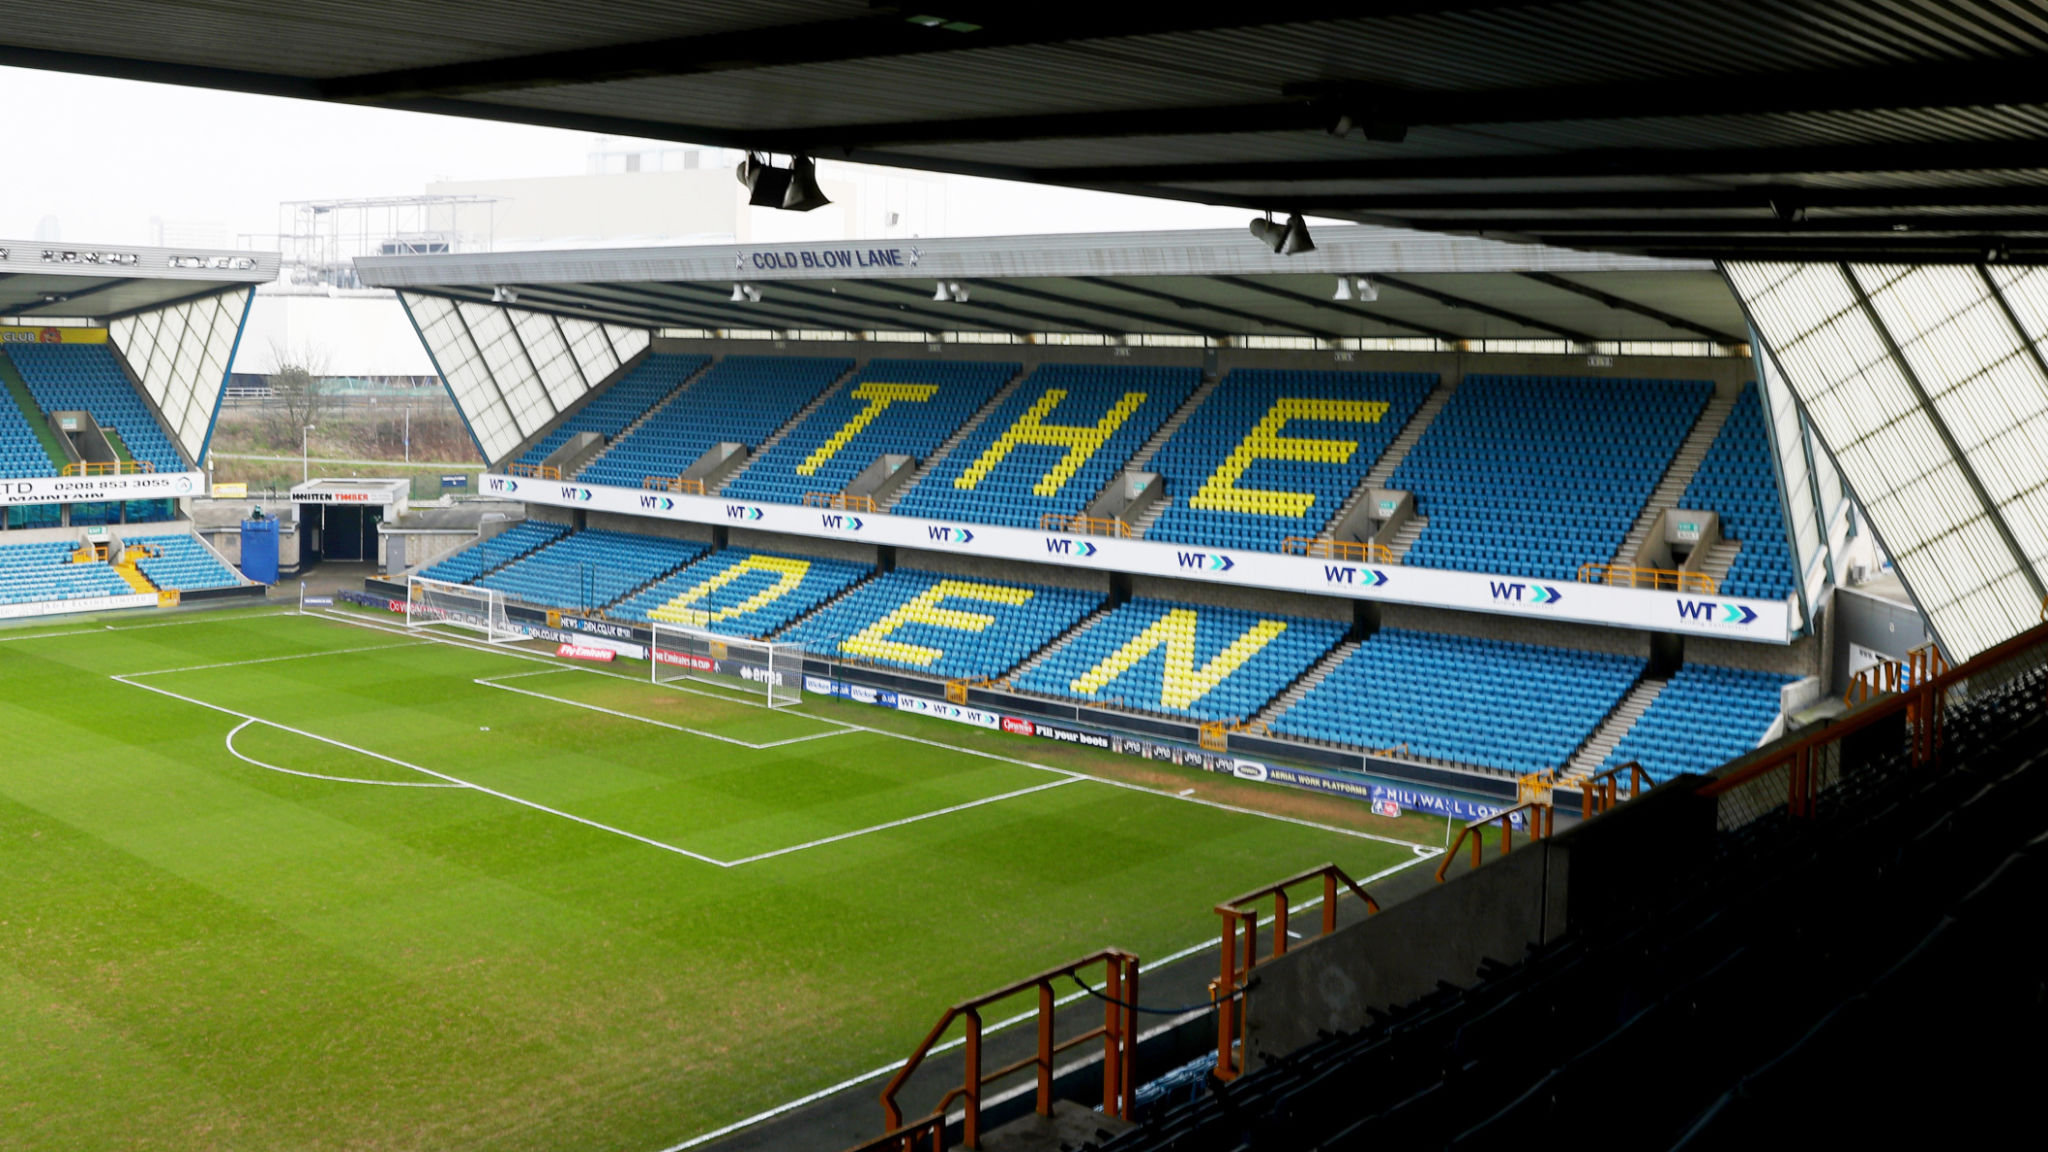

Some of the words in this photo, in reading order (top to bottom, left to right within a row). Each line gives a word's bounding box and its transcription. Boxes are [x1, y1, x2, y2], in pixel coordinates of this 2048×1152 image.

[751, 252, 798, 269] COLD
[800, 250, 852, 268] BLOW
[855, 248, 905, 267] LANE
[3, 331, 35, 341] CLUB
[795, 381, 1391, 519] THE
[0, 482, 33, 495] TD
[54, 482, 94, 491] 0208
[100, 480, 127, 489] 853
[133, 479, 170, 488] 3055
[489, 478, 504, 491] WT
[561, 486, 577, 500] WT
[640, 495, 657, 510] WT
[726, 505, 746, 521] WT
[822, 515, 843, 530] WT
[928, 526, 951, 542] WT
[1046, 538, 1072, 554] WT
[1177, 551, 1206, 569] WT
[1324, 565, 1357, 585] WT
[1490, 581, 1526, 601] WT
[1676, 599, 1717, 621] WT
[646, 553, 1289, 711] DEN
[560, 644, 574, 656] Fly
[574, 646, 613, 659] Emirates
[901, 697, 914, 709] WT
[934, 704, 947, 715] WT
[967, 710, 982, 722] WT
[1036, 724, 1053, 737] Fill
[1054, 729, 1079, 741] your
[1080, 732, 1109, 747] boots
[1270, 769, 1297, 782] AERIAL
[1297, 774, 1321, 786] WORK
[1322, 779, 1368, 796] PLATFORMS
[1468, 803, 1521, 823] LOTO
